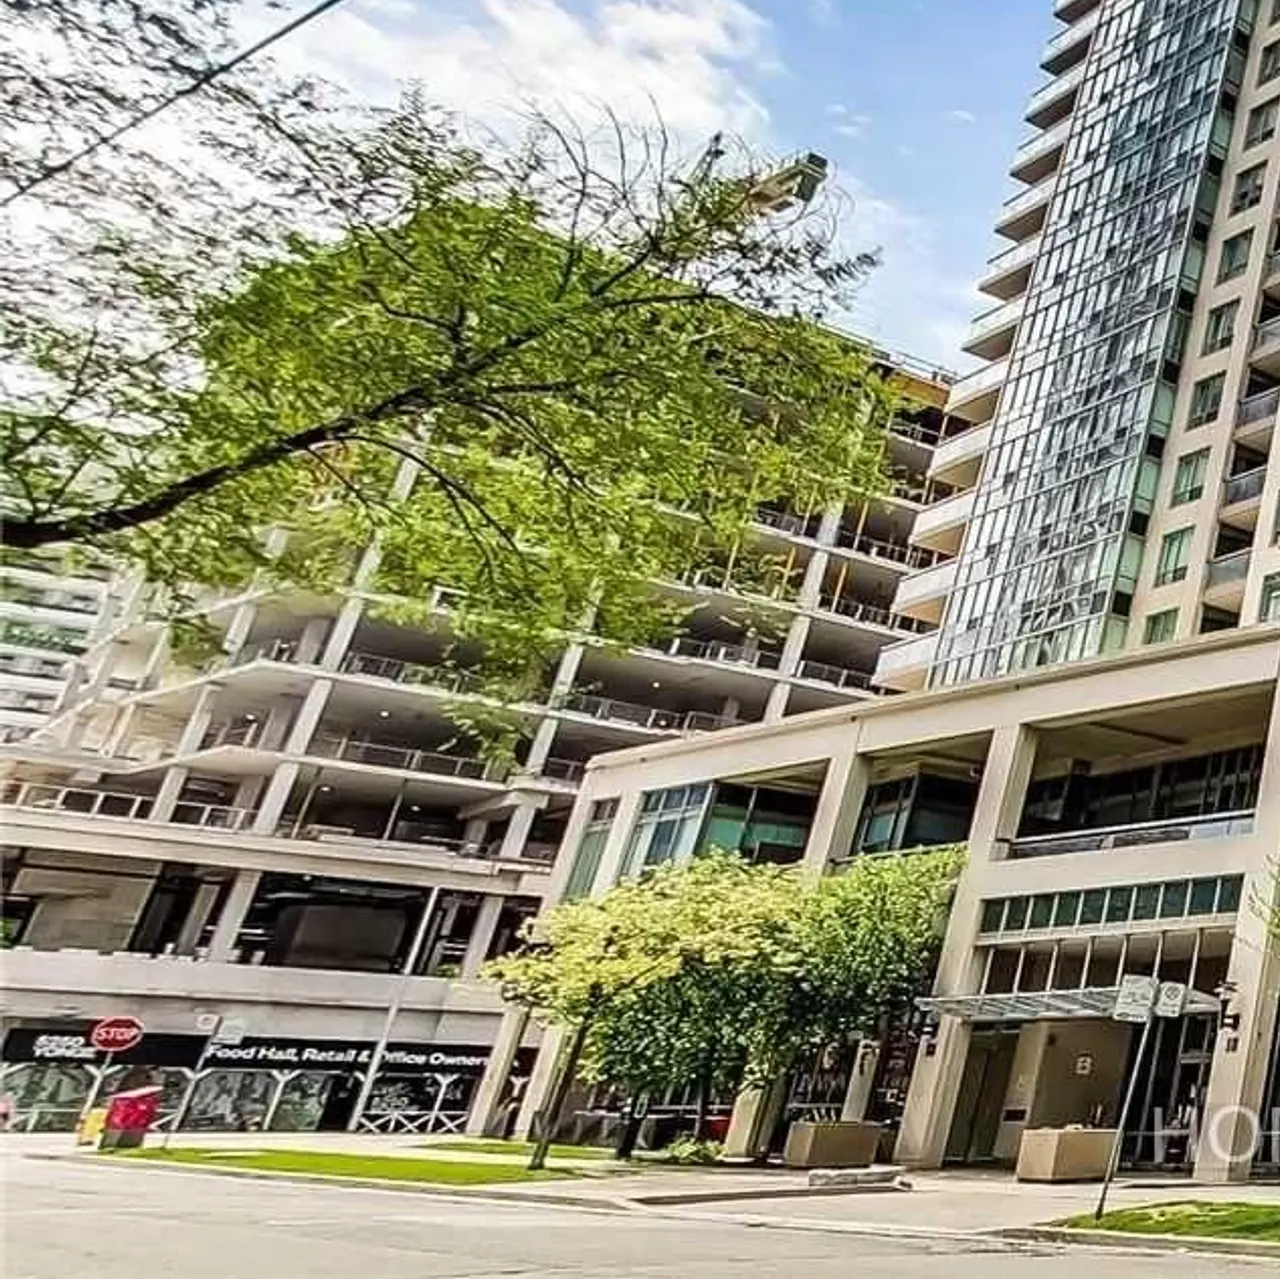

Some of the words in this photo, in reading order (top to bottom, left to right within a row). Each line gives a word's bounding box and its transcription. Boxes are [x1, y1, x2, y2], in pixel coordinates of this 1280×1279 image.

[97, 1027, 139, 1040] STOP
[206, 1044, 256, 1060] Food
[301, 1048, 357, 1063] Retail
[357, 1050, 372, 1063] &
